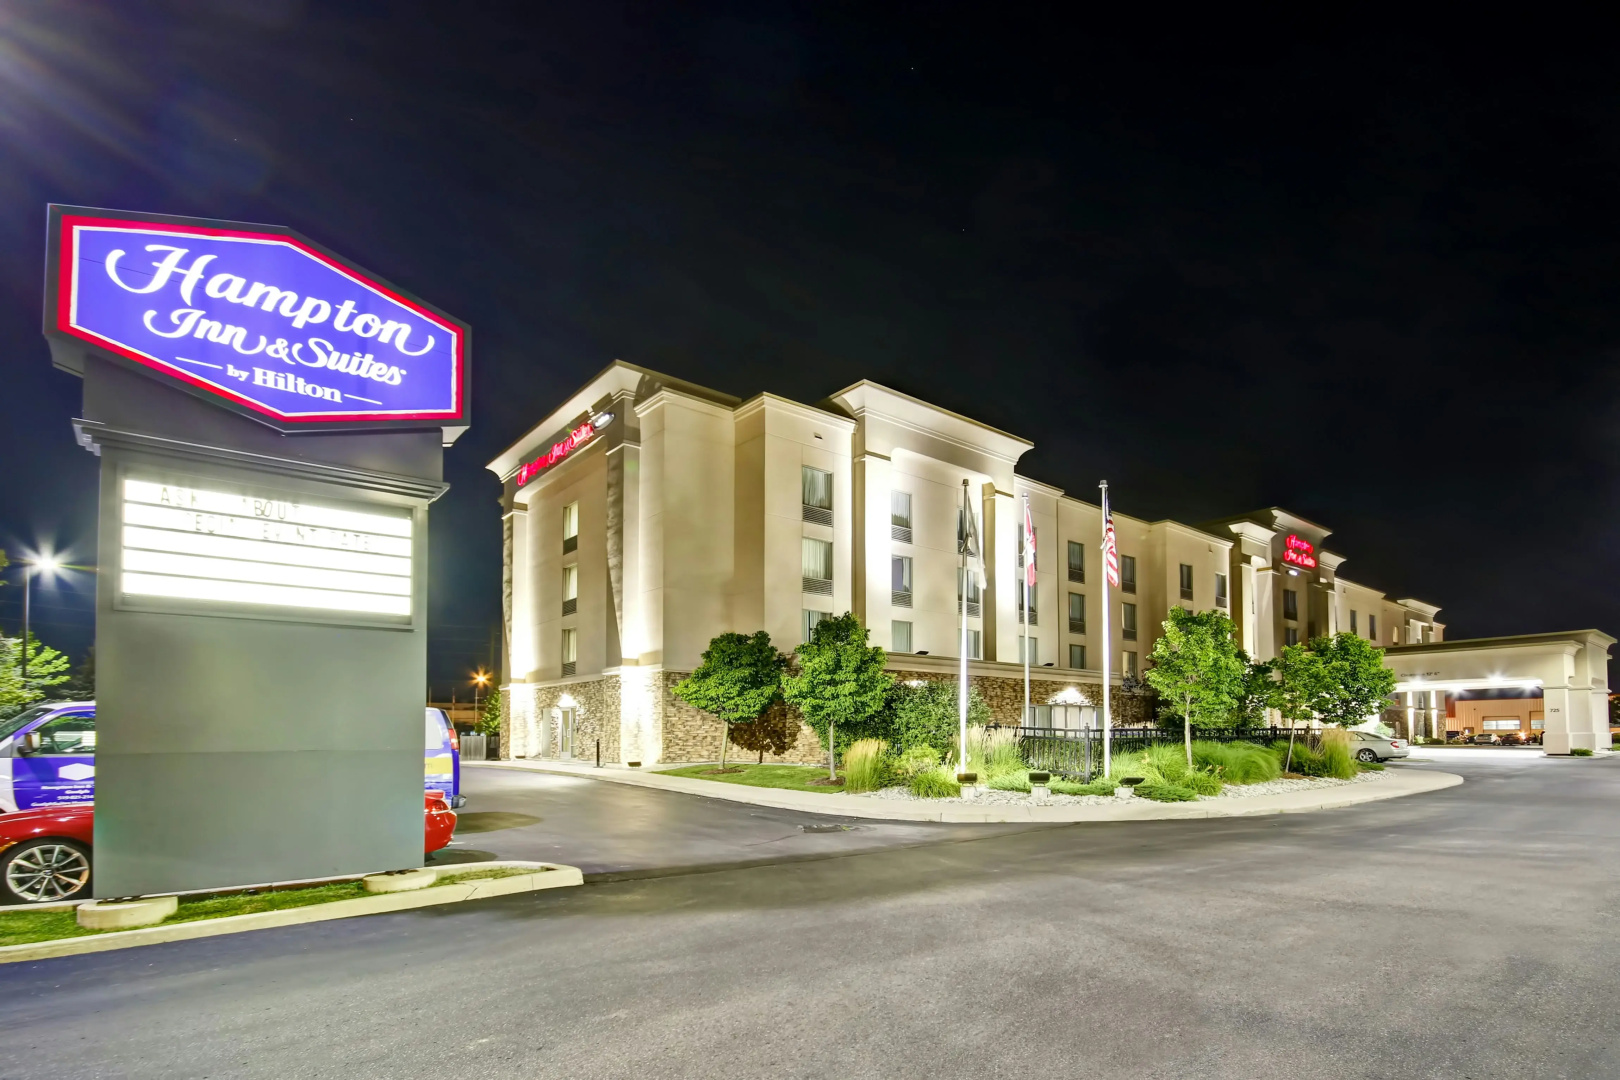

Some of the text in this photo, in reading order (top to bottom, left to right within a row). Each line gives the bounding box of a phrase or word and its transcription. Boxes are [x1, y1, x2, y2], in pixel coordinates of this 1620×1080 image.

[106, 245, 435, 356] Hampton
[143, 309, 406, 385] Inn & Suites
[226, 364, 342, 403] by Hilton
[241, 497, 300, 519] BOUT
